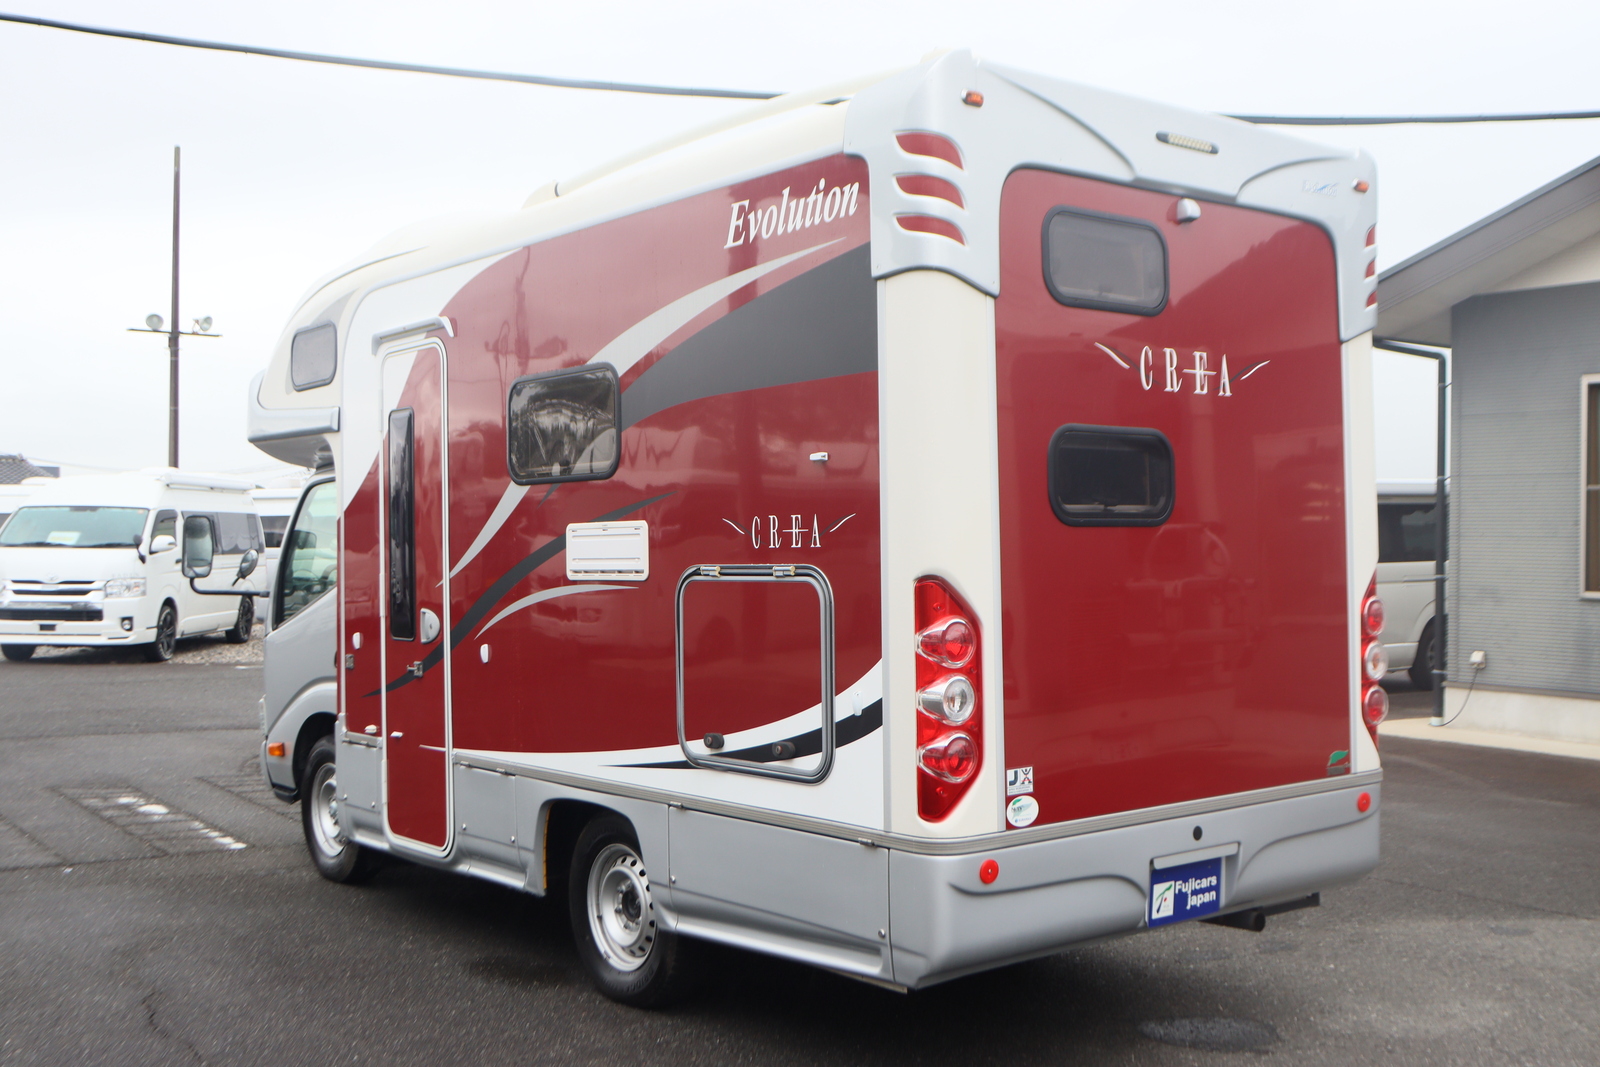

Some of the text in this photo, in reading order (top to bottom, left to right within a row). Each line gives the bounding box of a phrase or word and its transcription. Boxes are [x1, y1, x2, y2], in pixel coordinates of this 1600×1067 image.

[723, 178, 860, 249] Evolution
[1139, 345, 1232, 397] CREA
[751, 513, 821, 549] CREA
[1175, 875, 1217, 894] Fujicars
